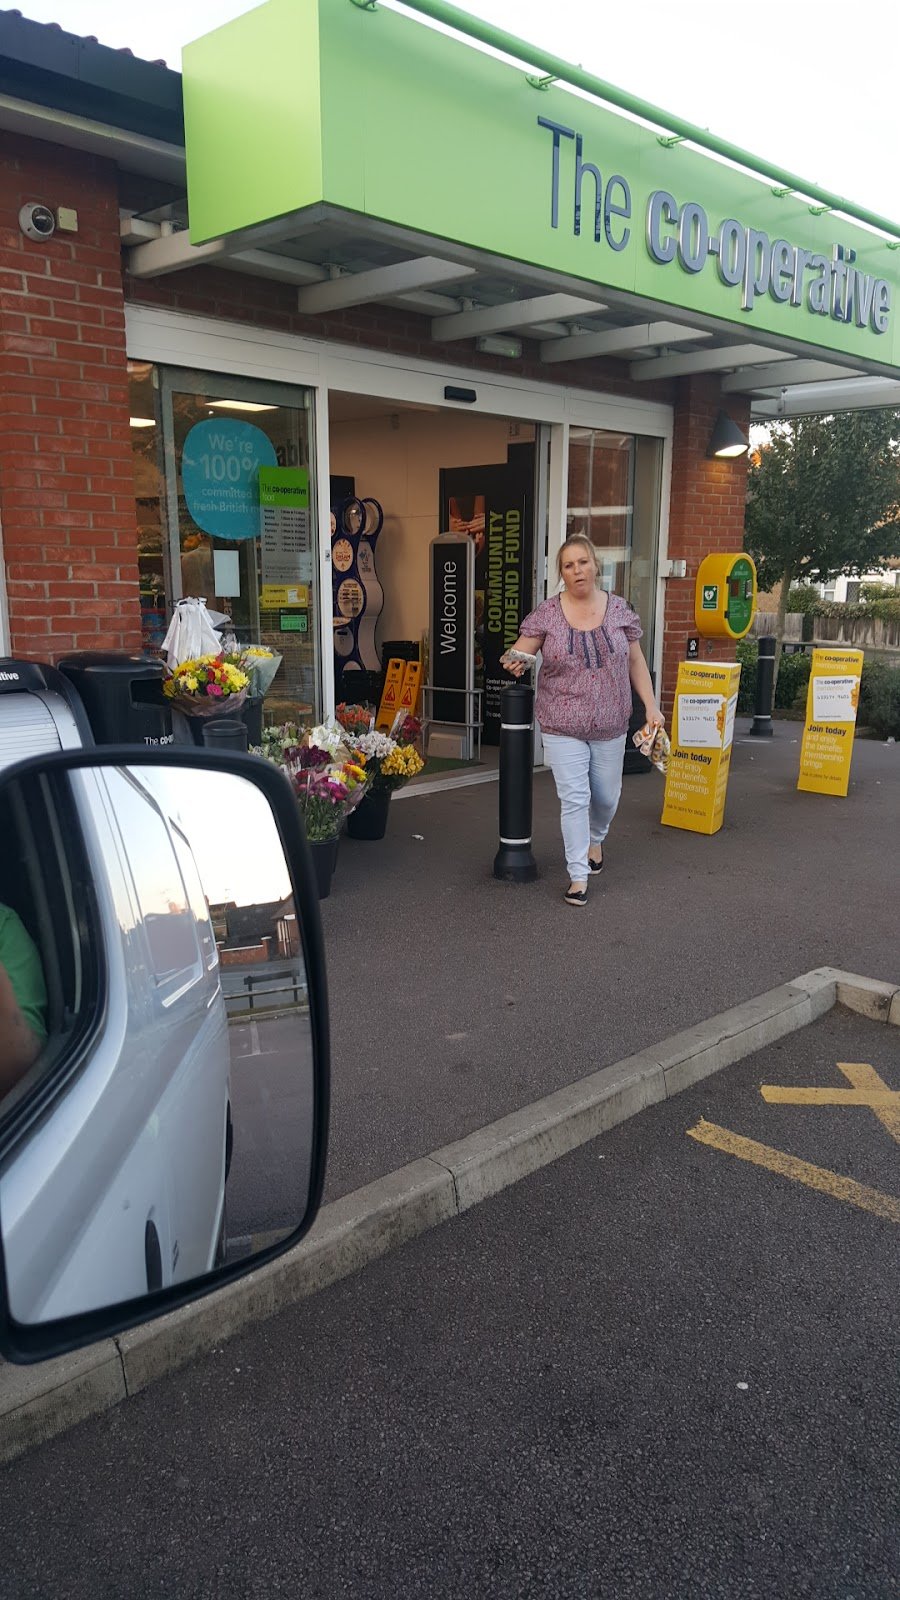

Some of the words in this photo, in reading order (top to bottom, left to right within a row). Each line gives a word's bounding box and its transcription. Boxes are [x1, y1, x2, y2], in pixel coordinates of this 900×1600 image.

[537, 115, 632, 251] The
[645, 190, 891, 334] co-operative
[208, 433, 253, 454] We're
[200, 453, 259, 483] 100%
[201, 485, 252, 499] committed
[272, 486, 307, 496] co-operative
[193, 500, 217, 513] fresh
[219, 500, 249, 515] British
[505, 509, 520, 563] FUND
[488, 511, 503, 633] COMMUNITY
[440, 561, 457, 655] Welcome
[504, 570, 519, 650] IVIDEND
[824, 655, 859, 663] co-operative
[690, 669, 726, 680] co-operative
[807, 724, 824, 732] Join
[825, 726, 847, 737] today
[143, 736, 159, 746] The
[805, 742, 816, 750] the
[672, 749, 689, 760] Join
[690, 752, 712, 765] today
[671, 760, 684, 768] and
[684, 763, 703, 774] enjoy
[670, 768, 681, 777] the
[681, 771, 708, 784] benefits
[667, 789, 688, 802] brings
[669, 780, 710, 796] membership
